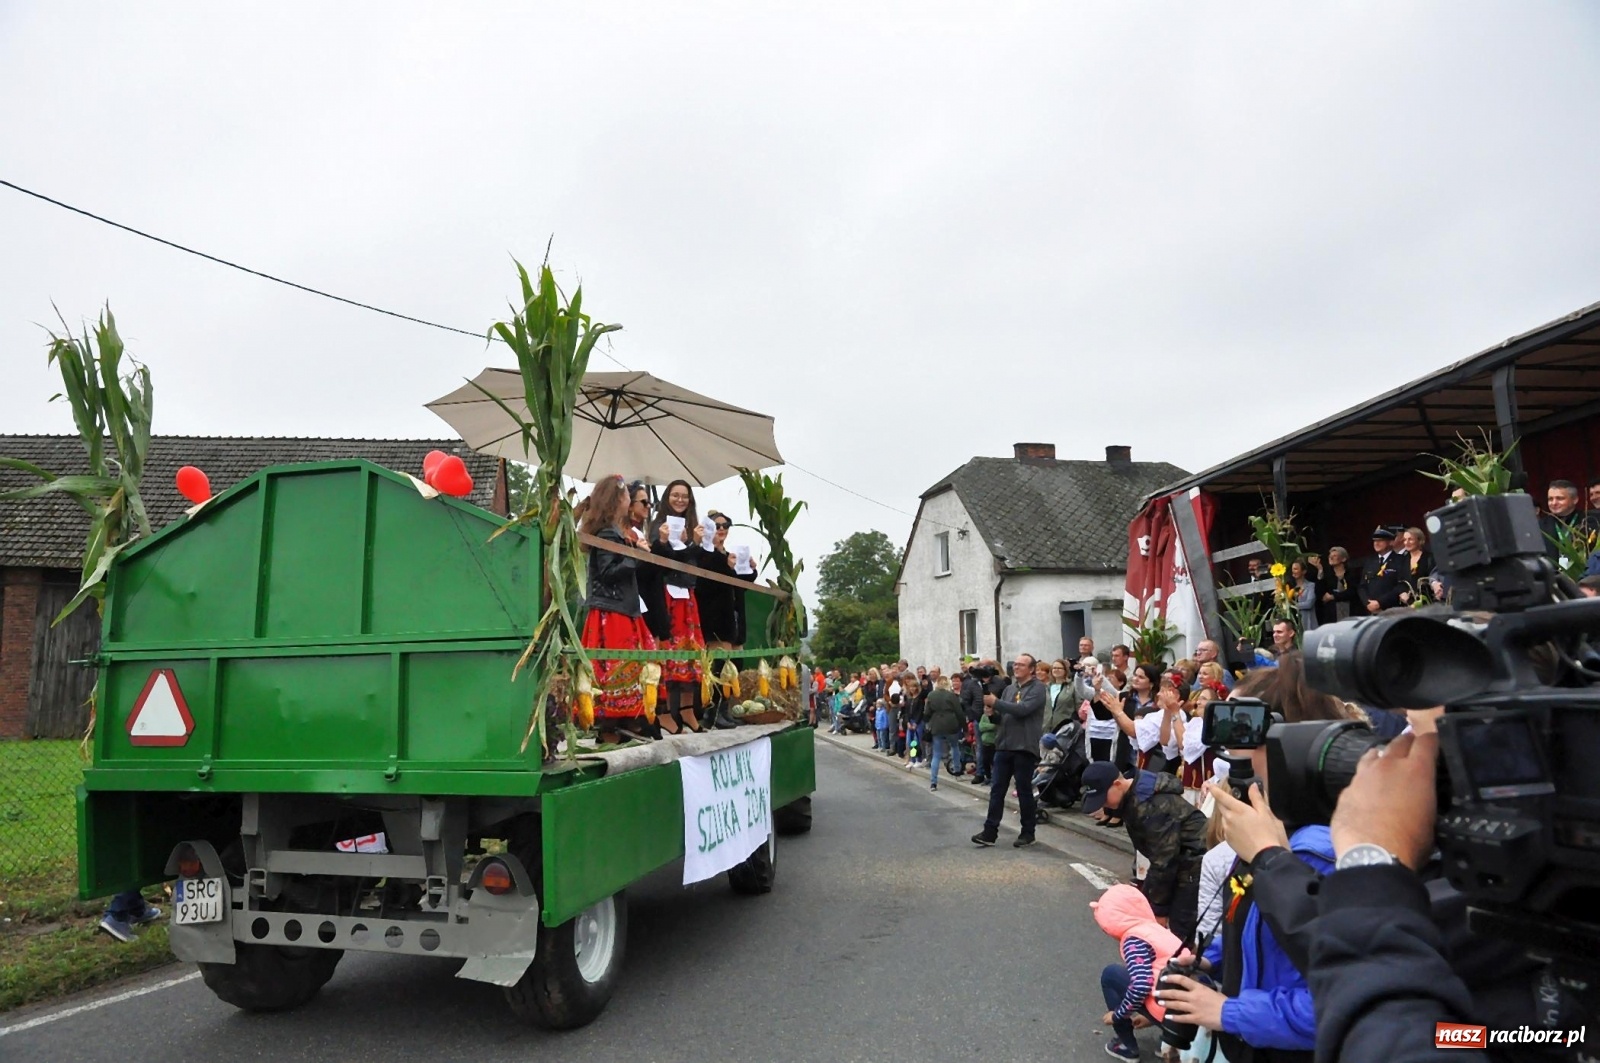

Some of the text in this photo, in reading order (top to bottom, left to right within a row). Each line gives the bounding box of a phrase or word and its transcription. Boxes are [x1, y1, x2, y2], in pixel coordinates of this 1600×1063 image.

[710, 749, 754, 792] ROLNIK
[697, 799, 741, 852] SZUKA
[186, 880, 216, 899] SRC
[180, 902, 217, 922] 93UJ
